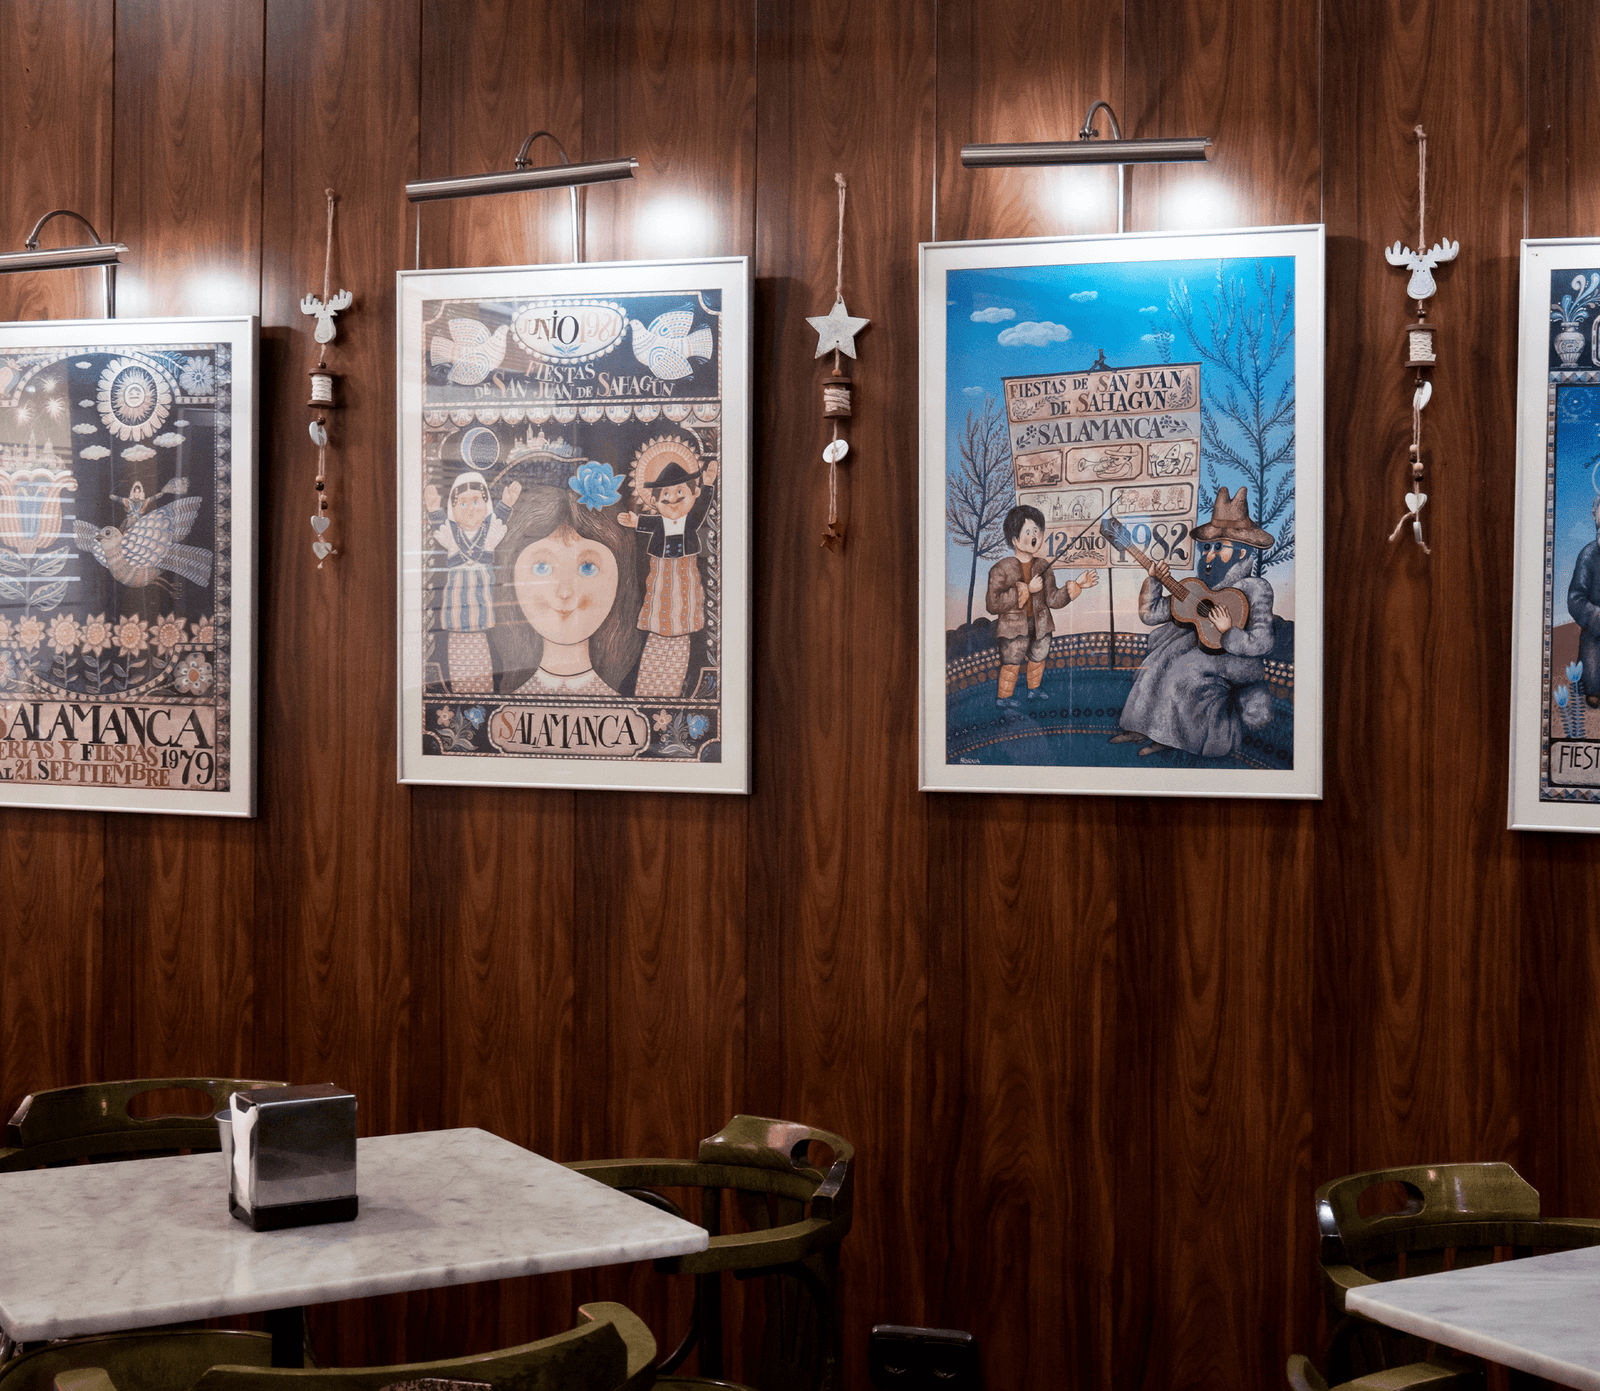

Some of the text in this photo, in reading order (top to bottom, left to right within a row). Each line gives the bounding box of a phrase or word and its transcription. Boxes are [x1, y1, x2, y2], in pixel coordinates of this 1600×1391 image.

[579, 312, 619, 343] 1981
[474, 382, 491, 399] DE
[492, 370, 530, 399] SAN
[533, 381, 575, 400] JUAN
[576, 386, 593, 399] DE
[524, 360, 595, 384] FIESTAS
[1009, 378, 1067, 400] FIESTAS
[1073, 377, 1089, 391] DE
[1096, 373, 1130, 393] SAN
[1050, 400, 1071, 416] DE
[1037, 417, 1164, 446] SALAMANCA
[1044, 531, 1068, 558] 12
[0, 703, 213, 750] ALAMANCA
[500, 710, 639, 748] SALAMANCA
[58, 741, 77, 760] Y
[80, 743, 158, 768] FIESTAS
[161, 749, 214, 785] 1979
